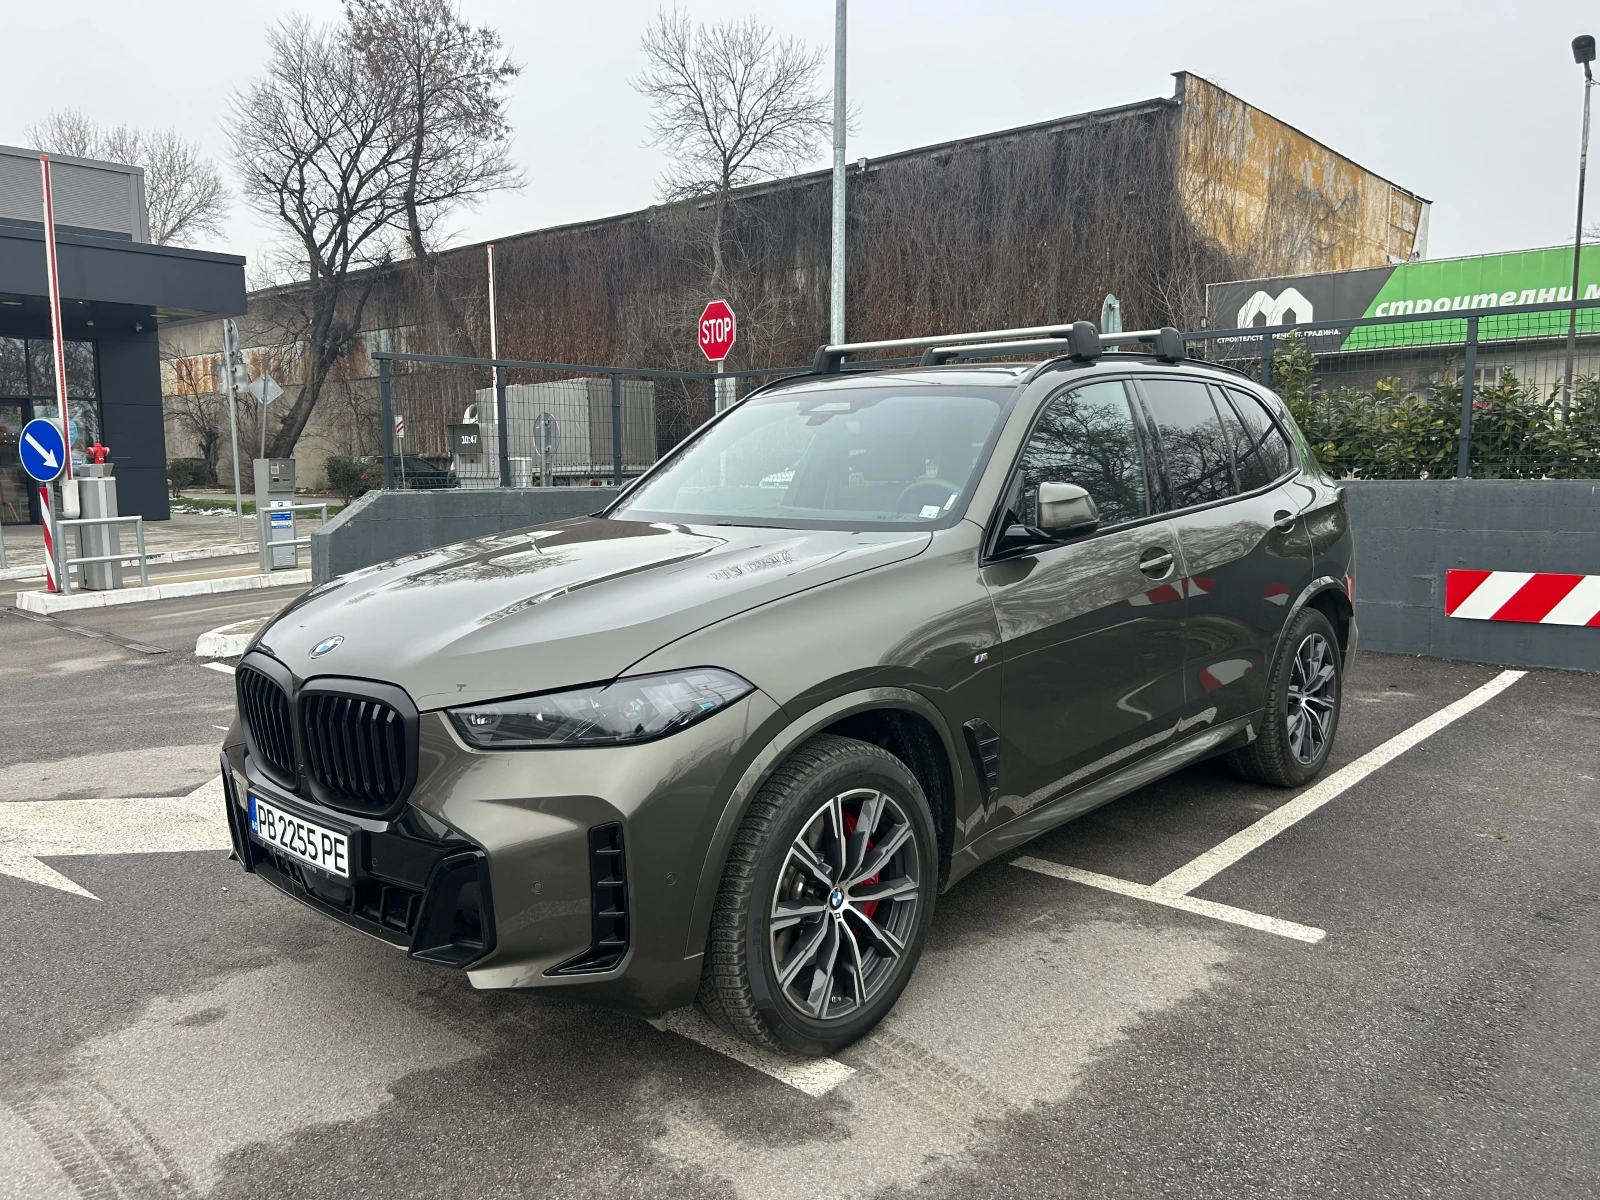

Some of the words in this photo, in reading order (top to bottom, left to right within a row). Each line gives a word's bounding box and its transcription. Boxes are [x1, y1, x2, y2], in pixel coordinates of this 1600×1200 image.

[702, 317, 732, 345] STOP
[461, 434, 478, 445] 10:47
[257, 803, 277, 841] PB
[278, 815, 318, 861] 2255
[321, 832, 347, 874] PE
